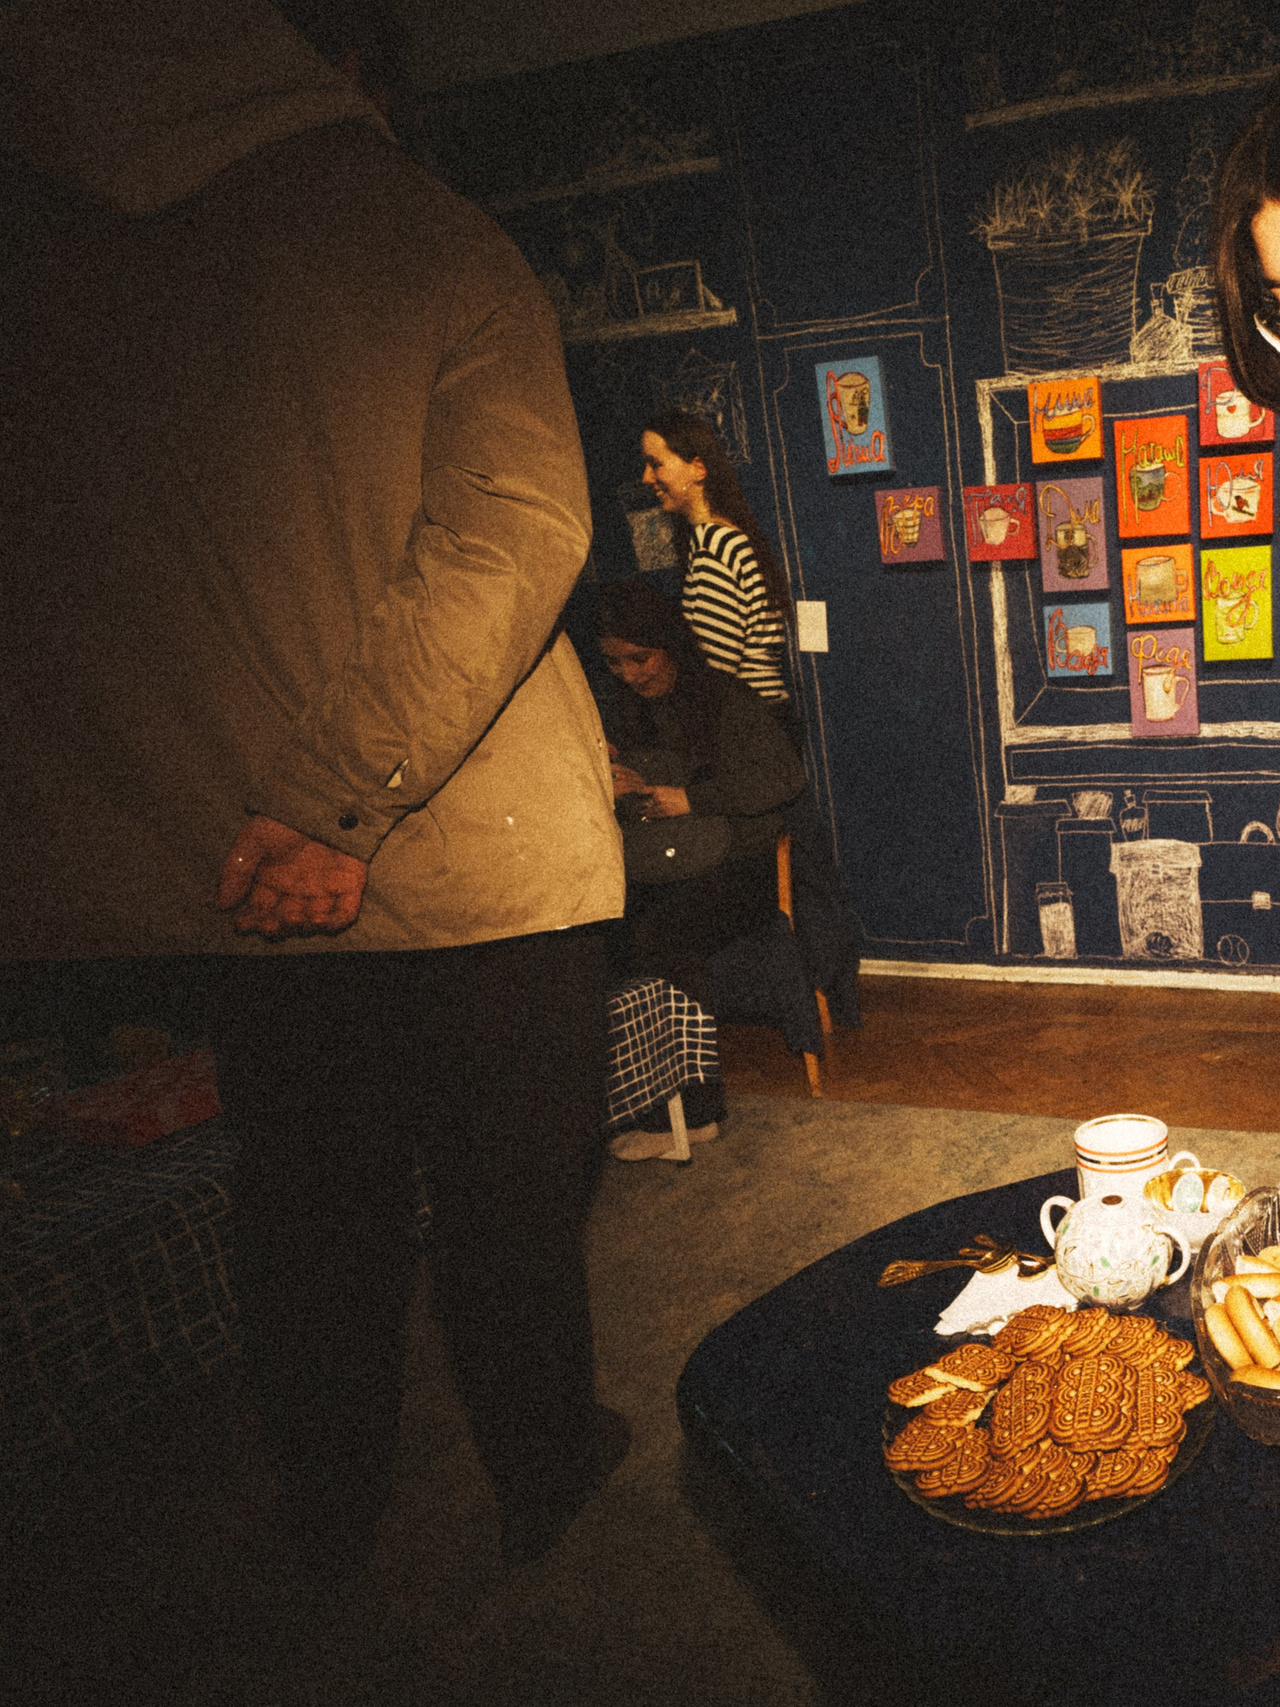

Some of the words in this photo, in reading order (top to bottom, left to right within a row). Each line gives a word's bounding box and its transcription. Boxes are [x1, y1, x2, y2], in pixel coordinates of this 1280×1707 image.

[1121, 427, 1185, 527] Наташа
[880, 494, 935, 556] Вера
[1131, 634, 1192, 694] Федя
